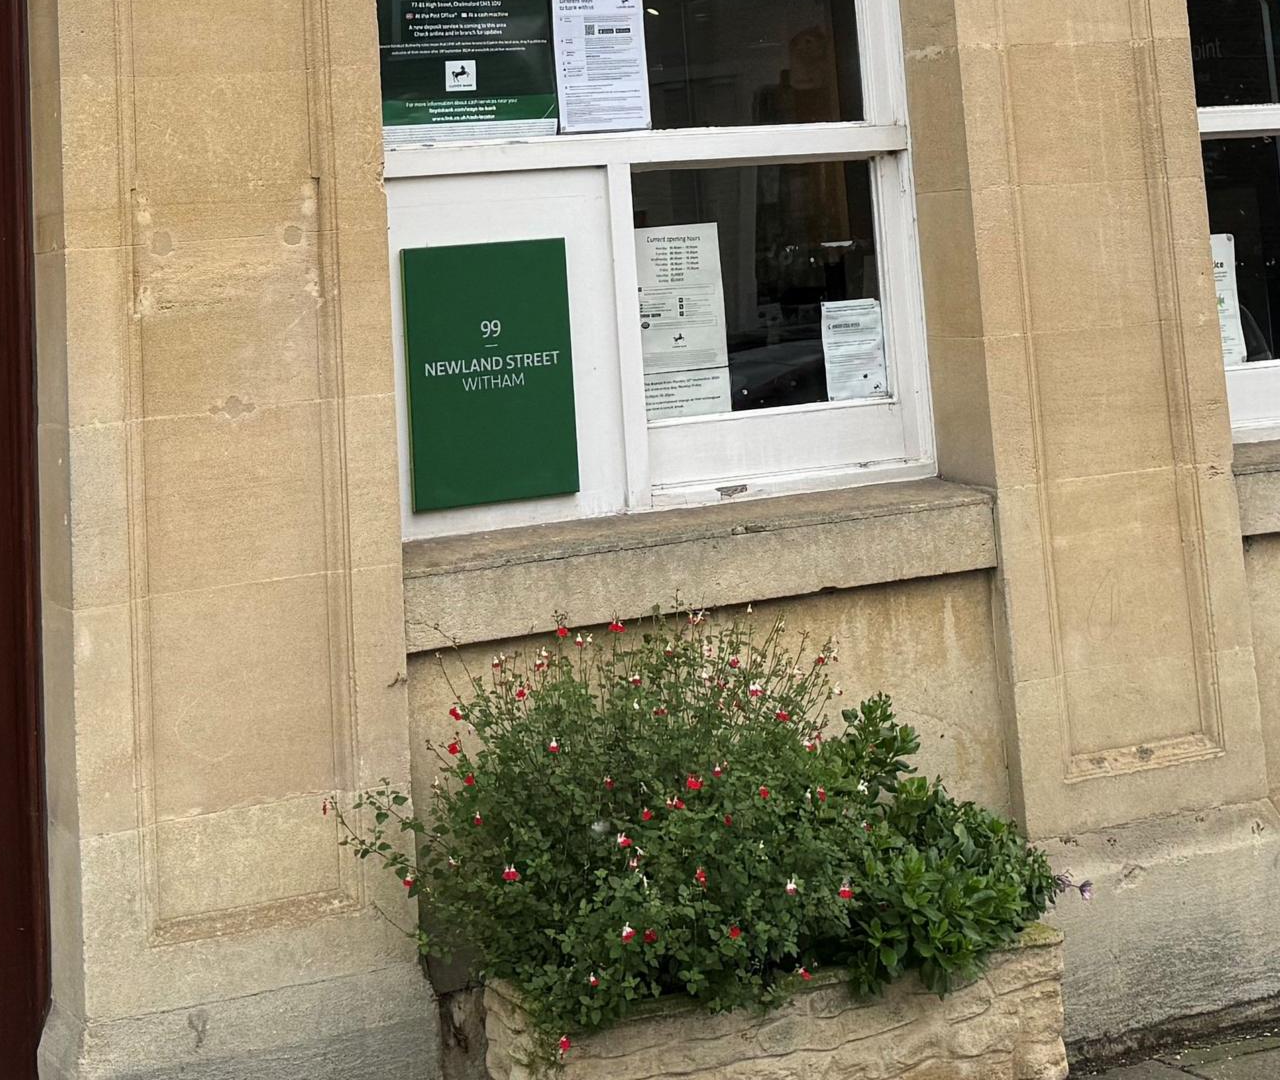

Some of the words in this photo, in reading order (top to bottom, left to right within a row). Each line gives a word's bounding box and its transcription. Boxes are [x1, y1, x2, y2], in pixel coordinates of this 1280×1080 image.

[480, 319, 501, 338] 99
[424, 355, 503, 377] NEWLAND
[506, 350, 560, 369] STREET
[462, 372, 525, 392] WITHAM
